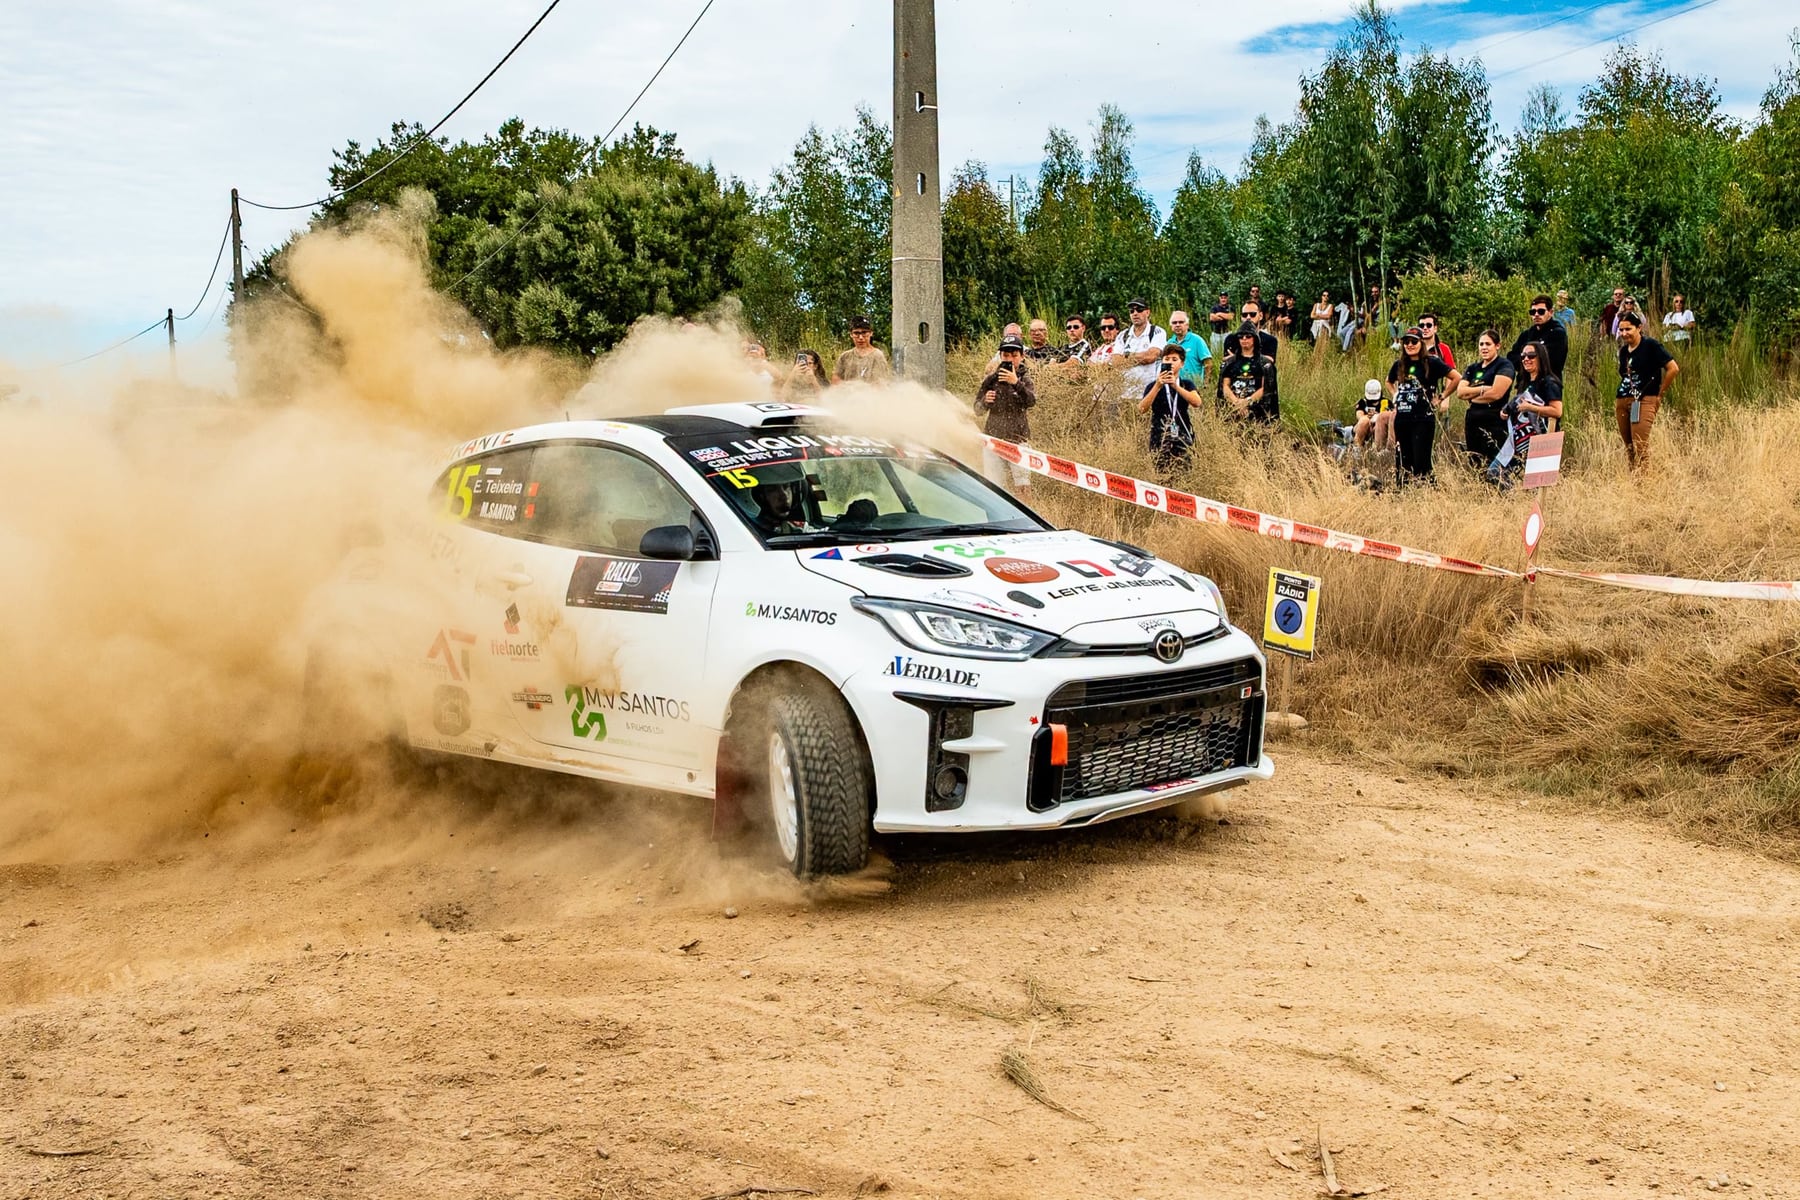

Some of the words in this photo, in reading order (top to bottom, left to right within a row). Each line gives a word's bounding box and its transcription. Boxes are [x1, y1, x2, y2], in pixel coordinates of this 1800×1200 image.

[730, 435, 821, 454] LIQUI
[707, 452, 773, 468] CENTURY
[485, 479, 523, 494] Teixeira
[719, 467, 760, 489] 15
[444, 464, 482, 521] 15
[479, 501, 518, 521] M.SANTOS
[602, 561, 641, 583] RALLY
[1277, 585, 1305, 600] RÁDIO
[757, 604, 838, 626] M.V.SANTOS
[584, 686, 691, 722] M.V.SANTOS
